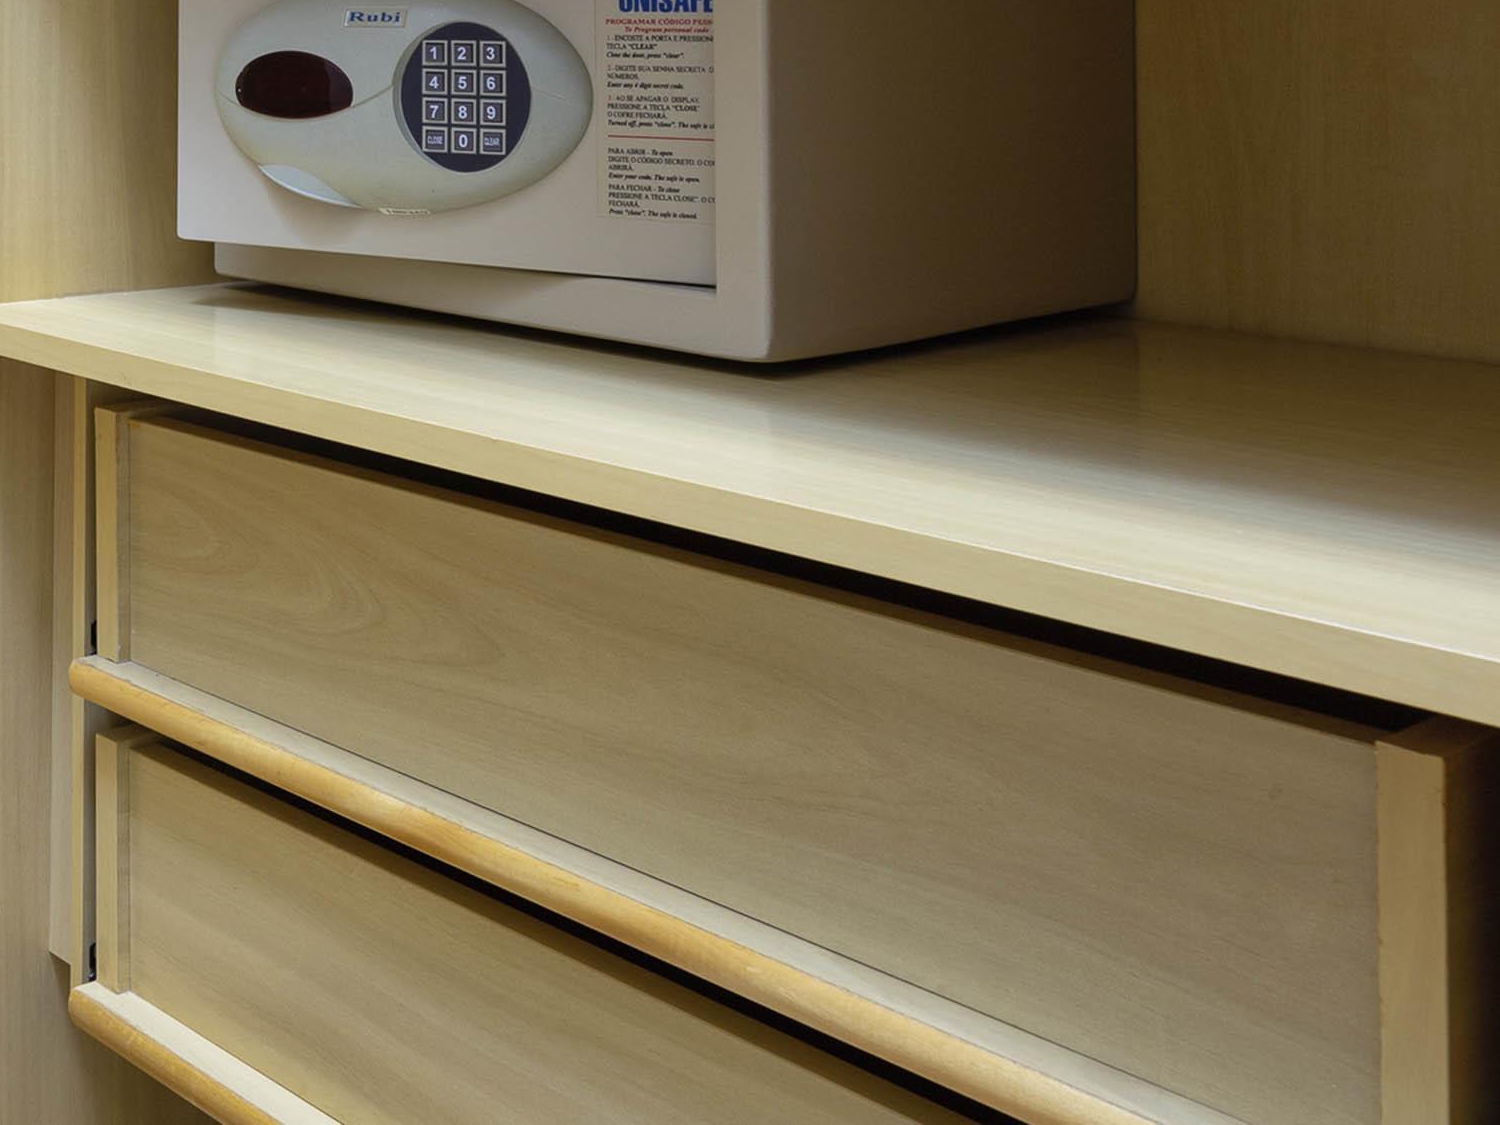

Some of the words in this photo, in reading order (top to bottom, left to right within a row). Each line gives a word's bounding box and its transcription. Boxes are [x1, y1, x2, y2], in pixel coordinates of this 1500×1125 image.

[349, 11, 401, 23] Rubi
[658, 17, 691, 25] CÓDIGO
[430, 46, 437, 59] 1
[457, 47, 467, 60] 2
[486, 47, 495, 60] 3
[429, 76, 439, 89] 4
[458, 77, 467, 90] 5
[486, 77, 496, 90] 6
[429, 105, 438, 118] 7
[458, 106, 467, 119] 8
[487, 106, 496, 119] 9
[459, 134, 468, 148] 0
